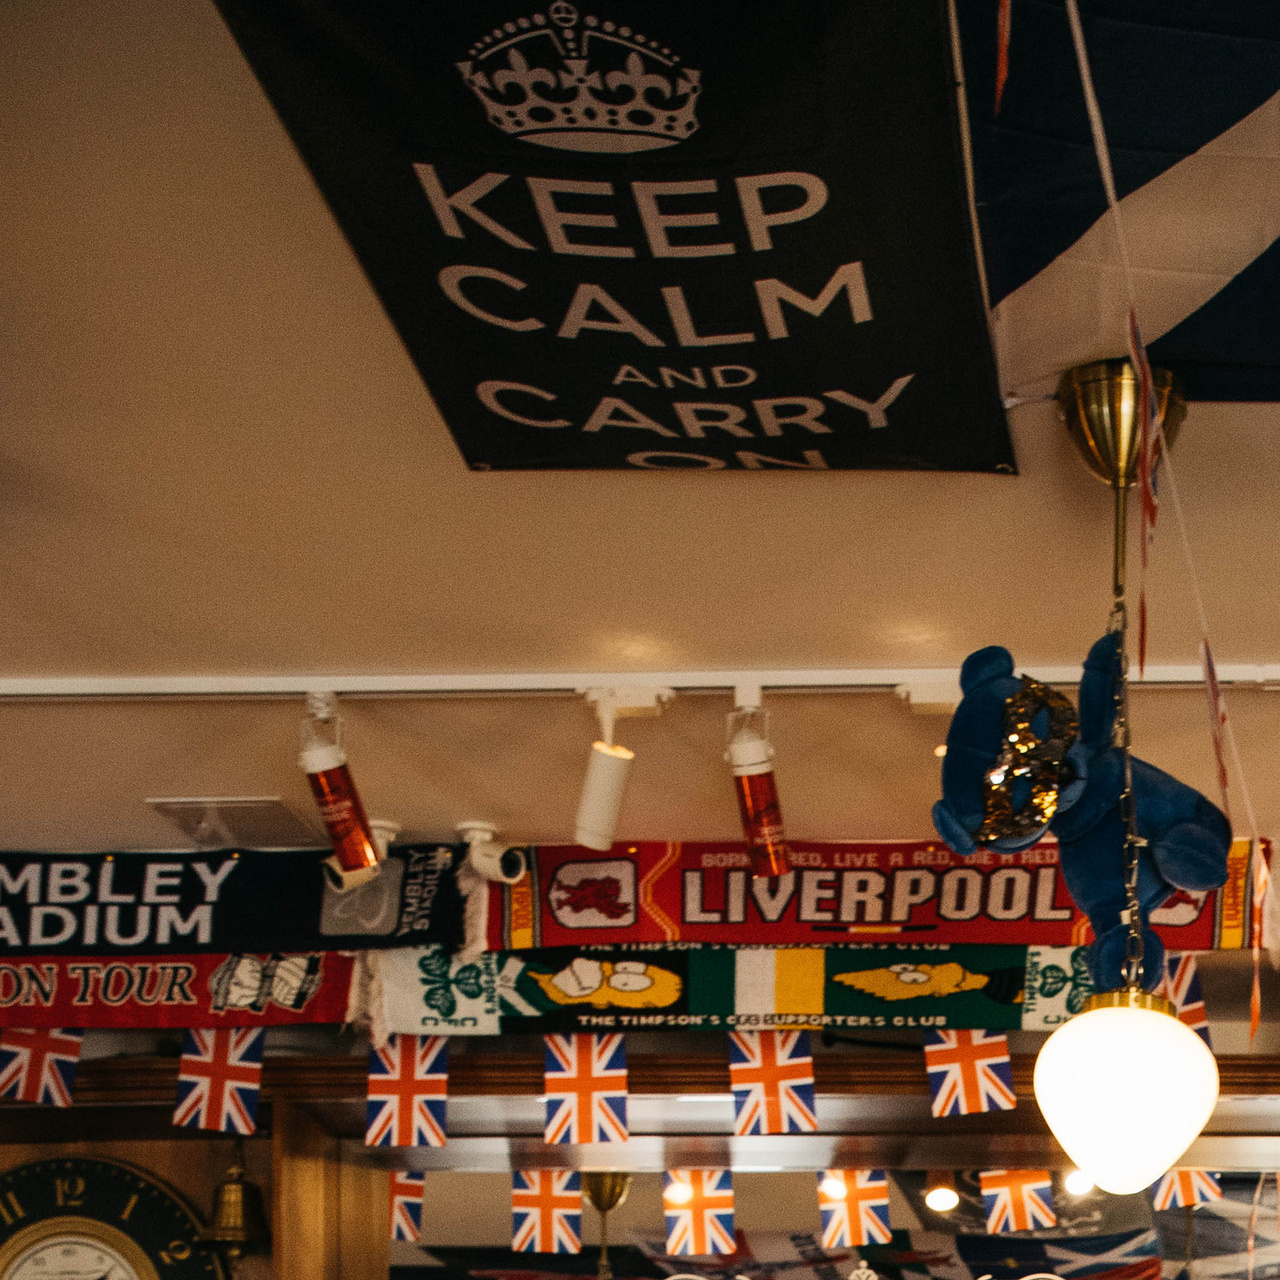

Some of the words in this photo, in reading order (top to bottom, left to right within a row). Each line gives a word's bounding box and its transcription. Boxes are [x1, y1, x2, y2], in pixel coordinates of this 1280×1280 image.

[412, 162, 830, 259] KEEP
[437, 261, 874, 348] CALM
[612, 364, 758, 390] AND
[475, 373, 915, 438] CARRY
[833, 852, 879, 868] LIVE
[890, 852, 904, 866] A
[1021, 849, 1059, 864] RED
[682, 867, 1073, 924] LIVERPOOL
[66, 961, 198, 1006] TOUR
[578, 1014, 615, 1026] THE
[619, 1014, 721, 1026] TIMPSON'S
[893, 1014, 948, 1027] CLUB
[54, 1176, 86, 1207] 12
[120, 1193, 139, 1222] 1
[159, 1239, 192, 1266] 2
